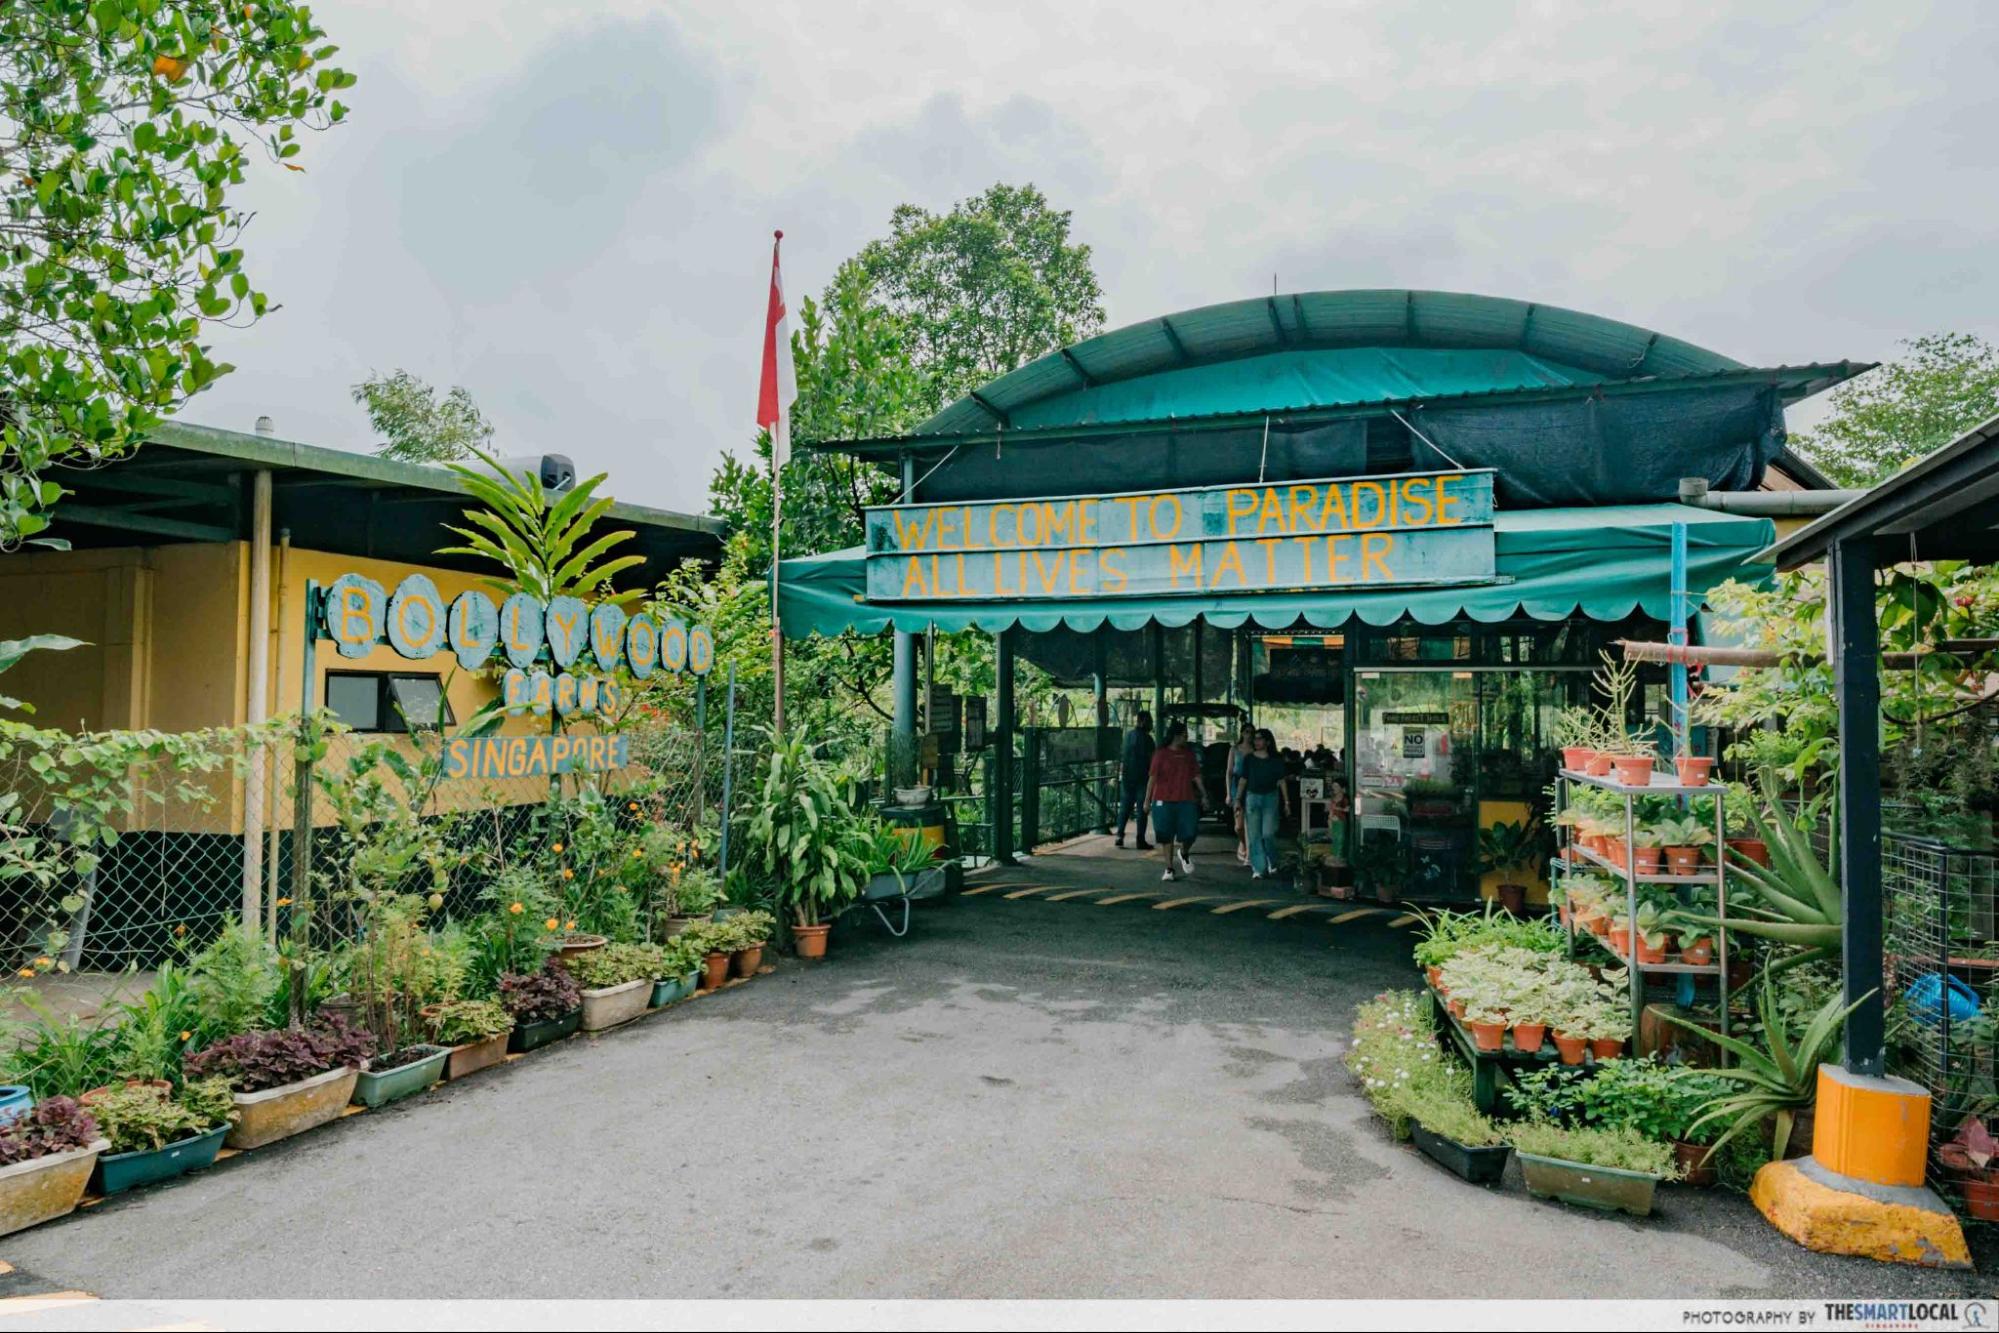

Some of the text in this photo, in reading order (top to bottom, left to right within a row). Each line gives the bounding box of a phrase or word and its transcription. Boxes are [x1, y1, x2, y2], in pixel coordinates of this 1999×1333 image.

[893, 475, 1463, 550] WELCOME TO PARADISE
[902, 532, 1394, 598] ALL LIVES MATTER
[341, 586, 713, 672] BOLLYWOOD
[508, 674, 618, 715] FARMS
[449, 736, 618, 778] SINGAPORE
[1404, 735, 1423, 744] NO
